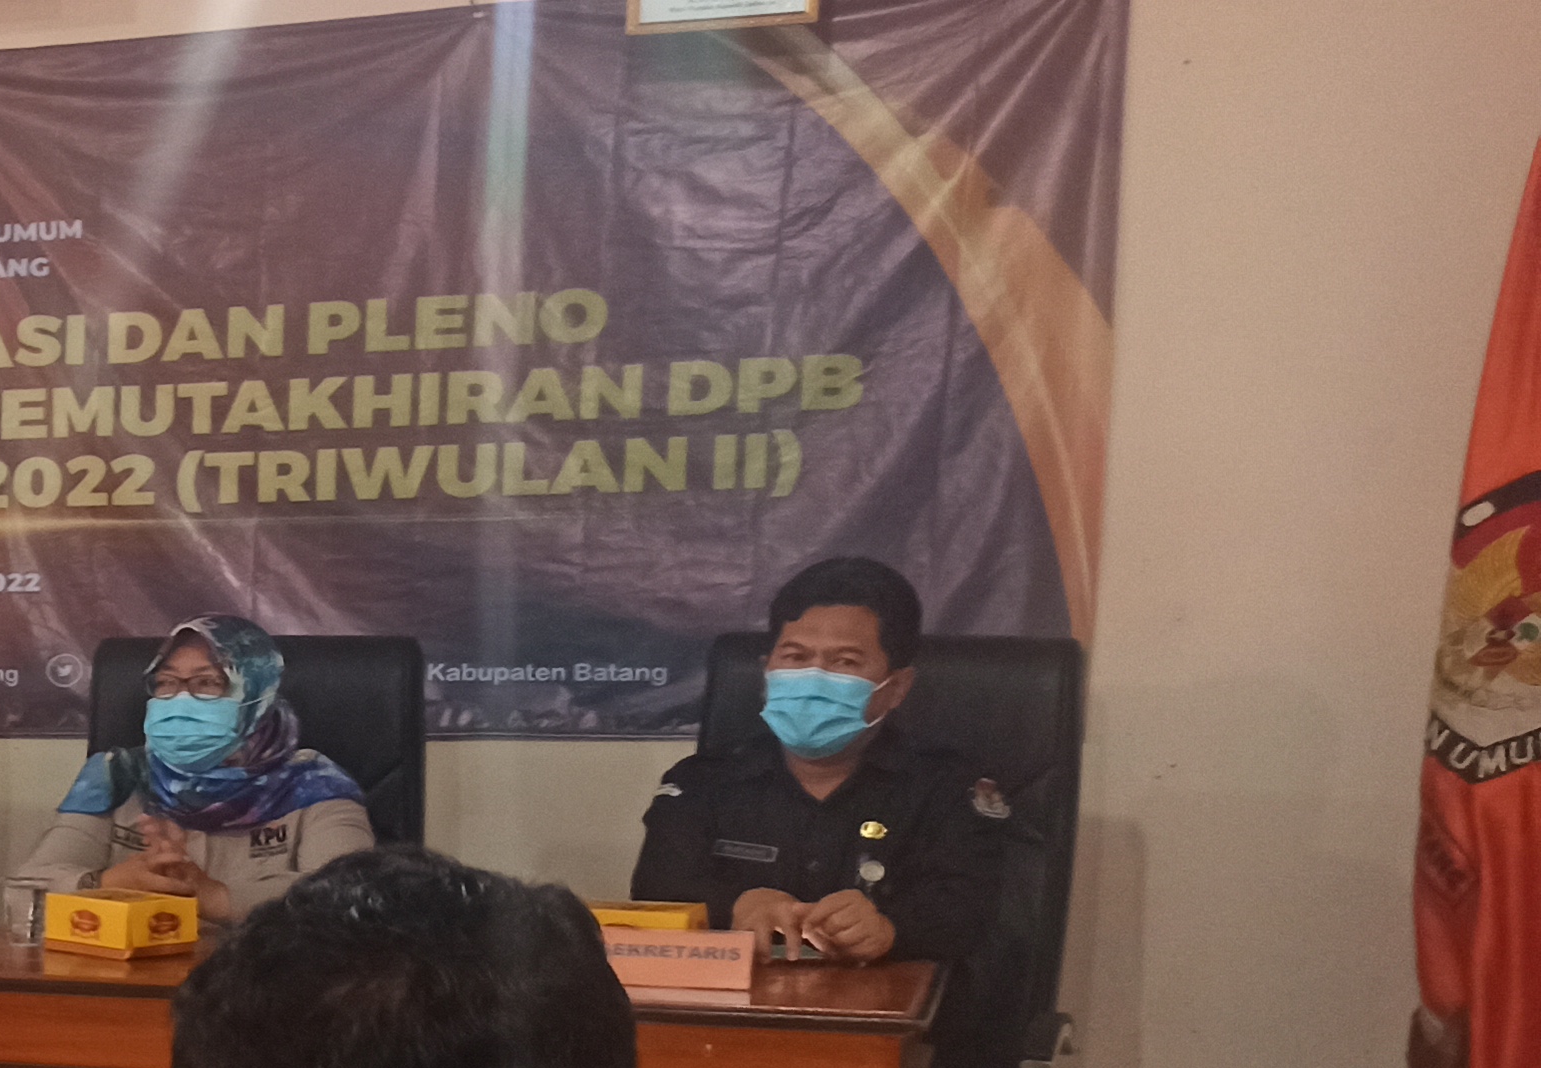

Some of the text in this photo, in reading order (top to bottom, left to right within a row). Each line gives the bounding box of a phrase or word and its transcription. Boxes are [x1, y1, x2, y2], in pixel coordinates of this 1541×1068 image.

[107, 303, 285, 364] DAN
[307, 287, 609, 356] PLENO
[667, 353, 866, 417] DPB
[176, 435, 690, 514] (TRIWULAN
[712, 428, 804, 499] II)
[426, 662, 668, 686] Kabupaten Batang
[1449, 733, 1541, 778] UMU
[249, 823, 288, 848] KPU
